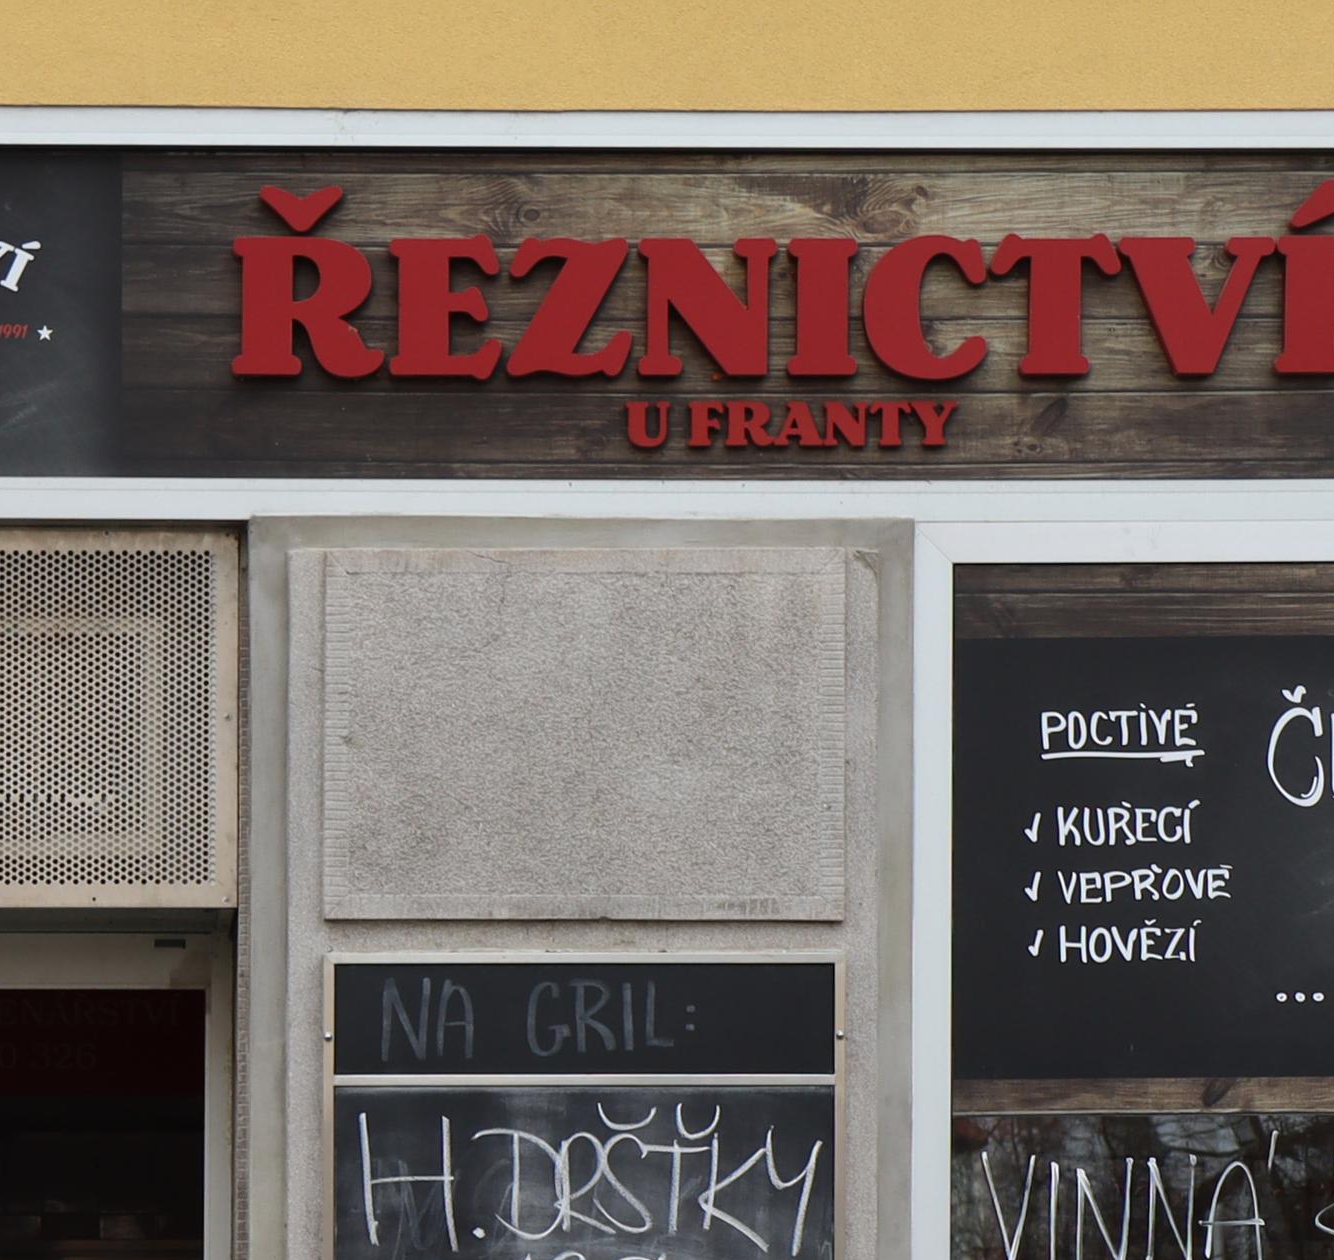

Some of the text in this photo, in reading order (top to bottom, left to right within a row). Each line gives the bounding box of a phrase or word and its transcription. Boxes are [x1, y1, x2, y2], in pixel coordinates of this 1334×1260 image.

[627, 402, 957, 446] U FRANTY
[1041, 702, 1198, 751] POCTIVÉ
[1057, 799, 1200, 847] KUŘECÍ
[1058, 863, 1233, 904] VEPŘOVÉ
[1058, 918, 1203, 964] HOVĚZÍ
[381, 976, 698, 1062] NA GRIL:
